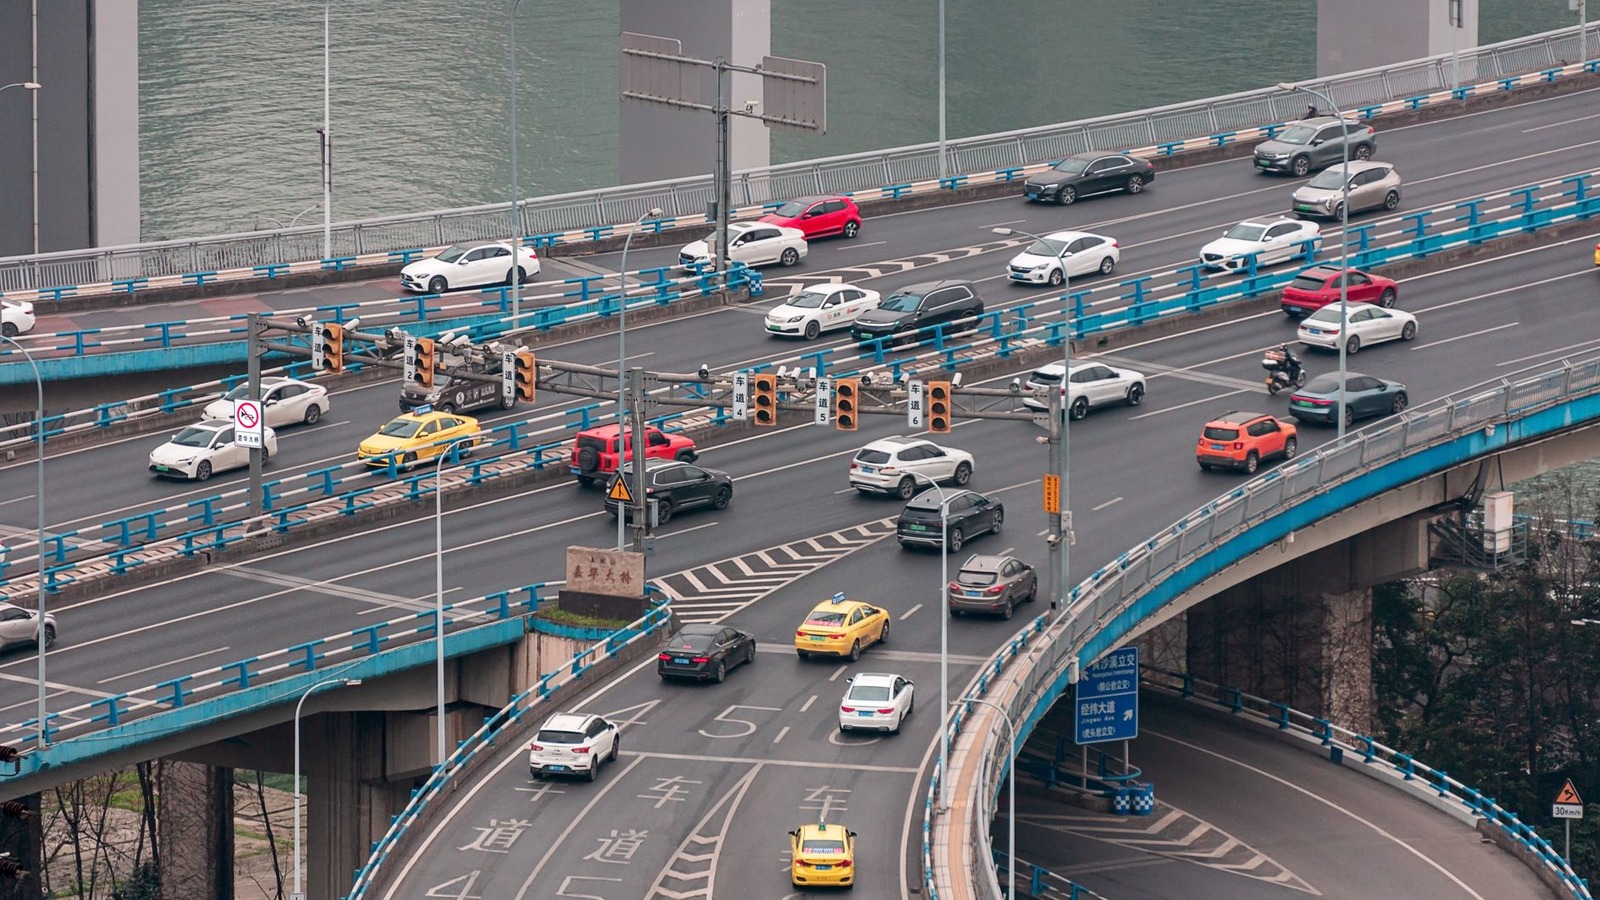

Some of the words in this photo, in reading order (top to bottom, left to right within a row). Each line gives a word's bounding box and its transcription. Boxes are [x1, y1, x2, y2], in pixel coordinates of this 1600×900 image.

[406, 339, 414, 379] 车道2
[505, 354, 513, 394] 车道3
[735, 376, 745, 416] 车道4
[818, 381, 828, 421] 车道5
[910, 384, 920, 425] 车道6
[698, 704, 782, 739] 5
